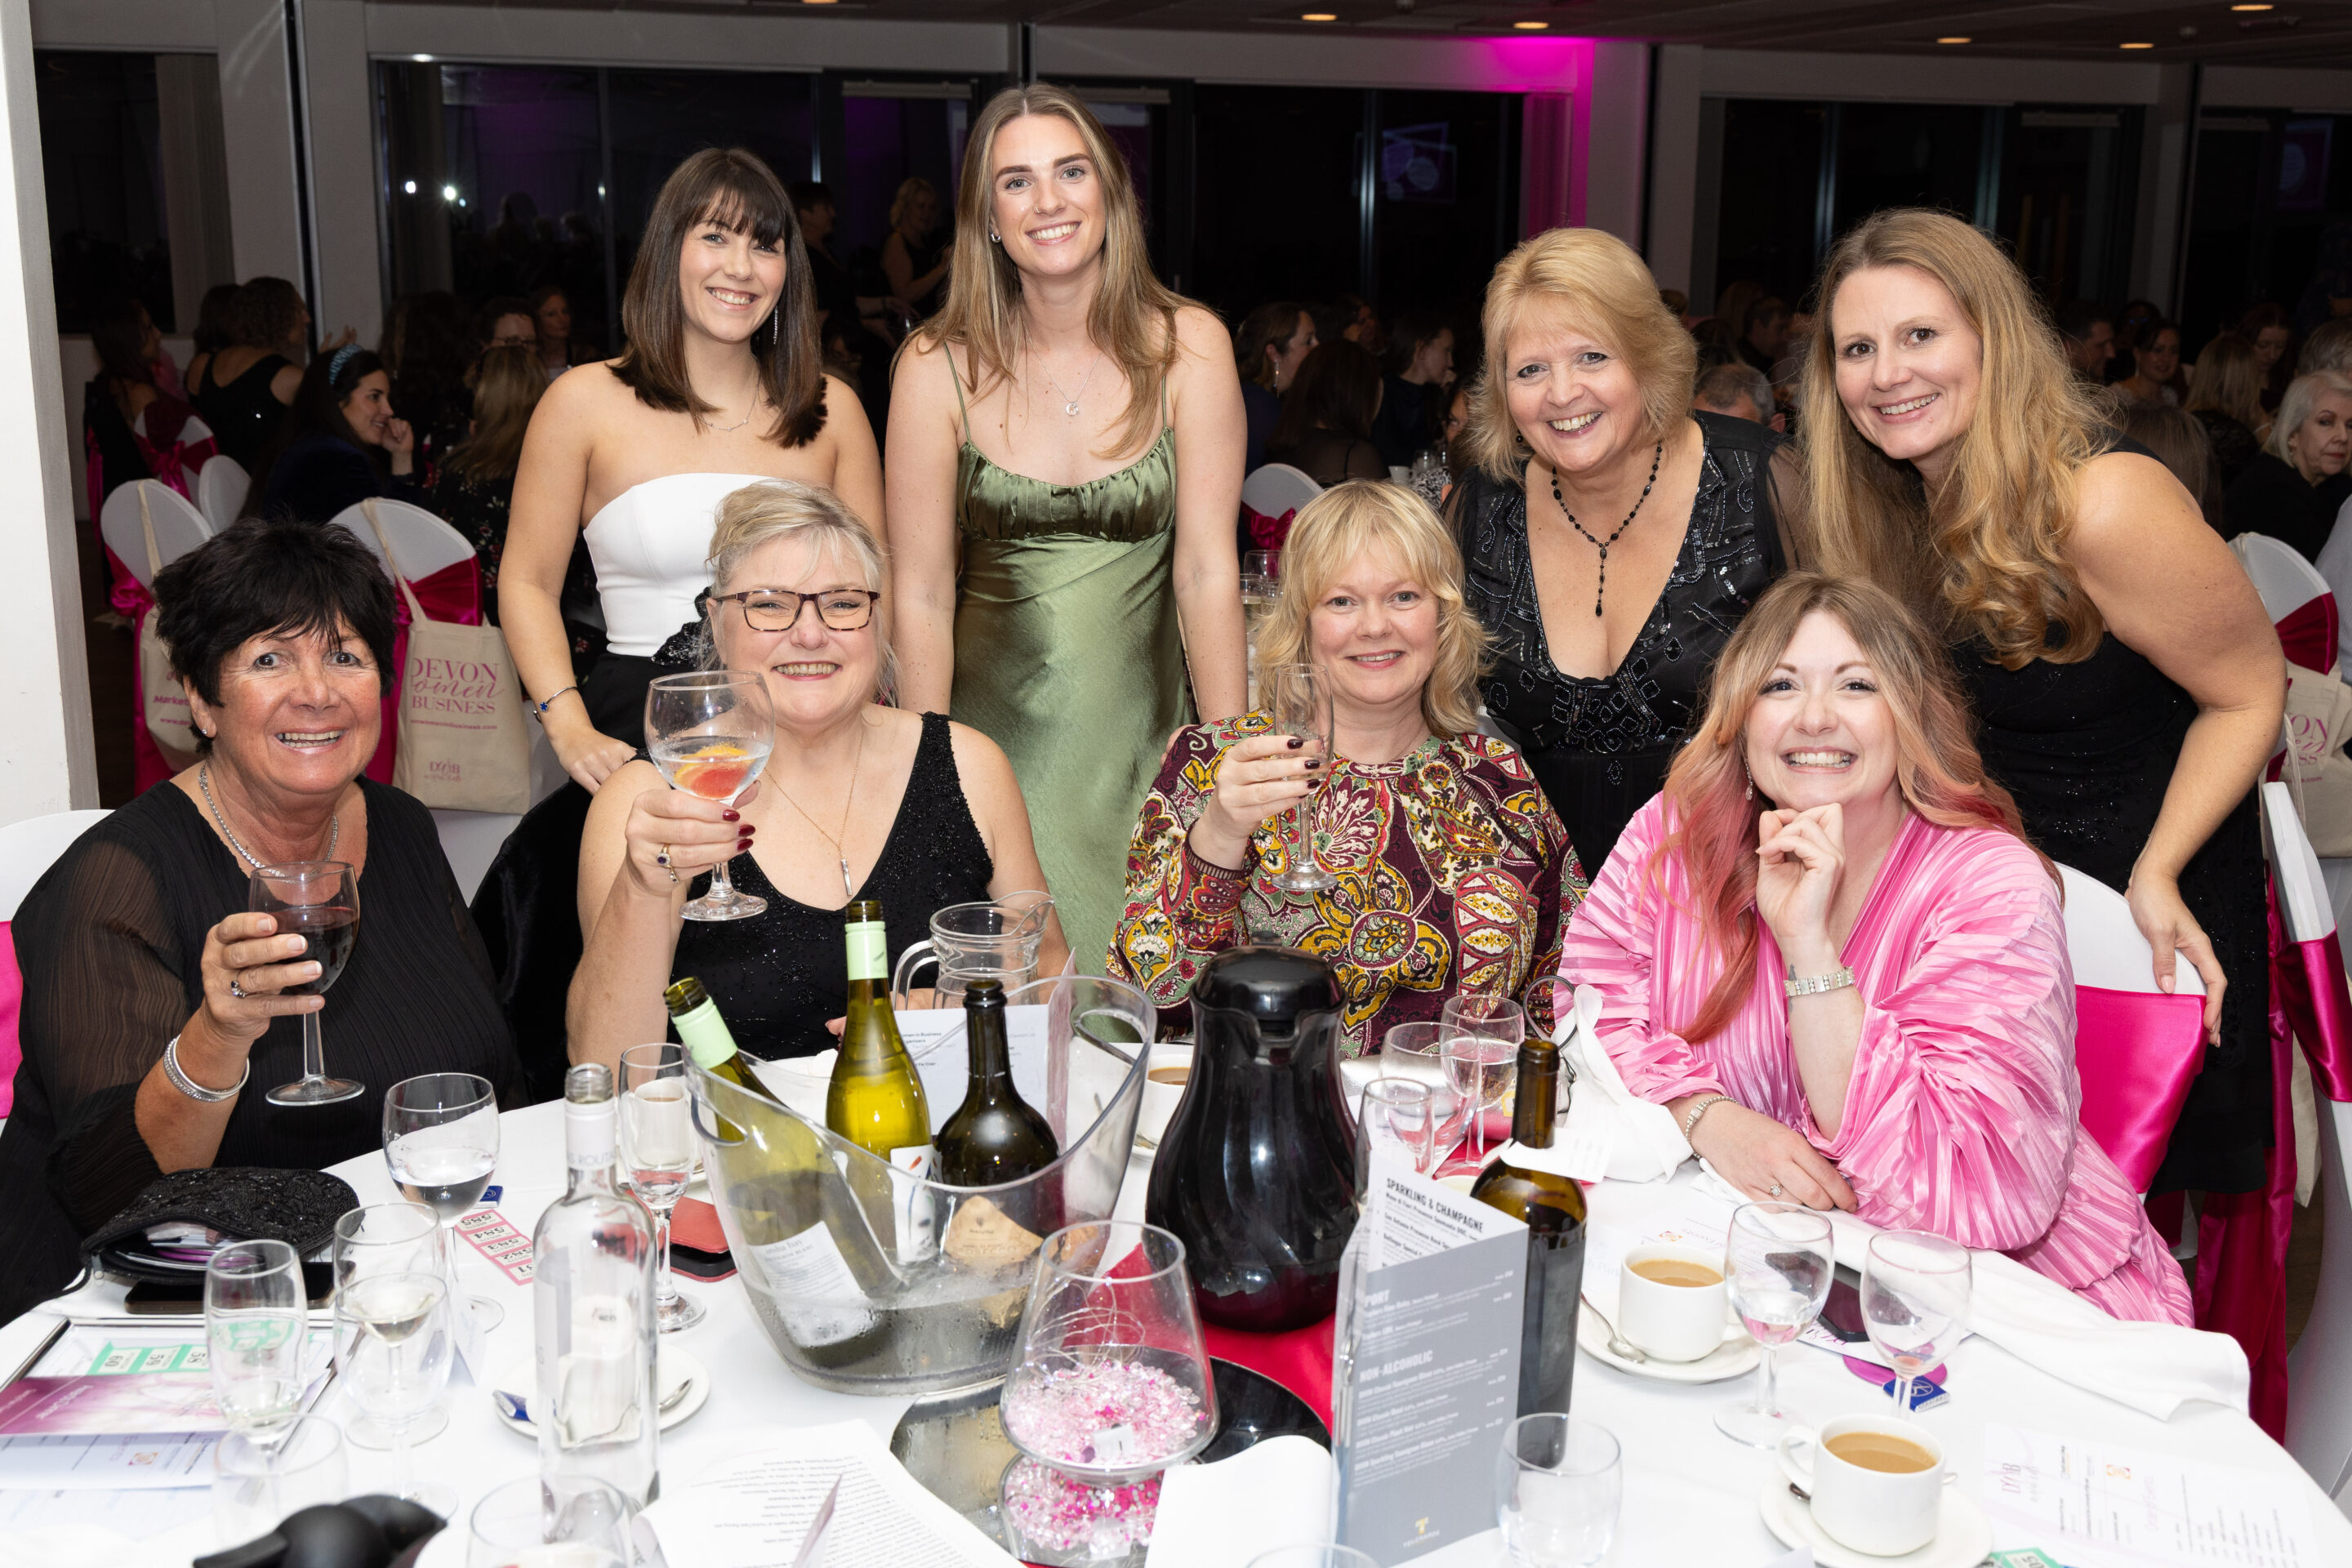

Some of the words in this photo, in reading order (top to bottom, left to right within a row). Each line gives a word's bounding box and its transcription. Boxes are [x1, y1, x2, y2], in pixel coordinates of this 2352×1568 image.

[412, 657, 500, 684] DEVON
[412, 678, 506, 699] omen
[412, 695, 497, 715] BUSINESS
[1387, 1178, 1427, 1206] SPARKLING
[1428, 1198, 1434, 1209] &
[1436, 1201, 1484, 1234] CHAMPAGNE
[461, 1214, 492, 1225] 585
[474, 1227, 505, 1239] 584
[1365, 1290, 1390, 1308] PORT
[1359, 1350, 1433, 1383] NON-ALCOHOLIC
